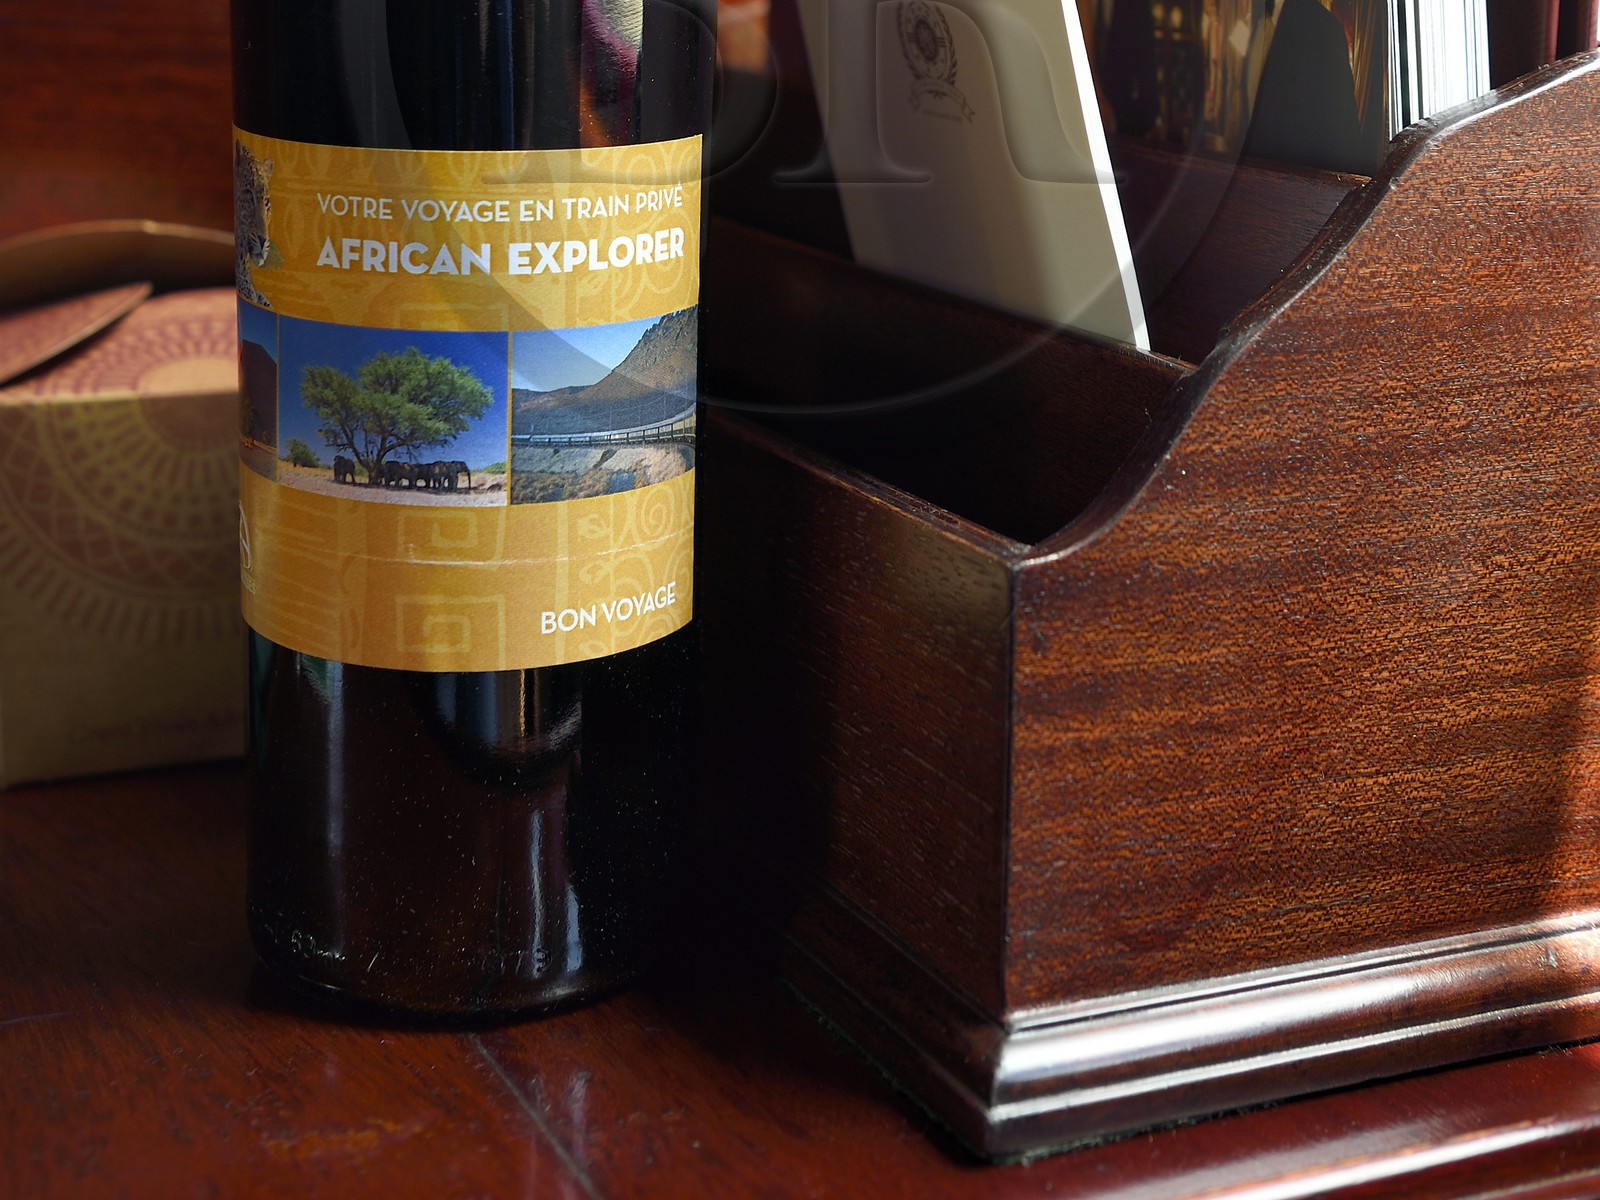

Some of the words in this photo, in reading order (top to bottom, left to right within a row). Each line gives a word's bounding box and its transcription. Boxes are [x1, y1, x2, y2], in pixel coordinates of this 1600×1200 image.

[316, 192, 393, 220] VOTRE
[400, 199, 511, 222] VOYAGE
[519, 199, 554, 222] EN
[562, 193, 629, 220] TRAIN
[635, 180, 683, 214] PRIVÉ
[316, 235, 491, 276] AFRICAN
[508, 227, 685, 275] EXPLORER
[541, 604, 597, 634] BON
[601, 581, 677, 623] VOYAGE
